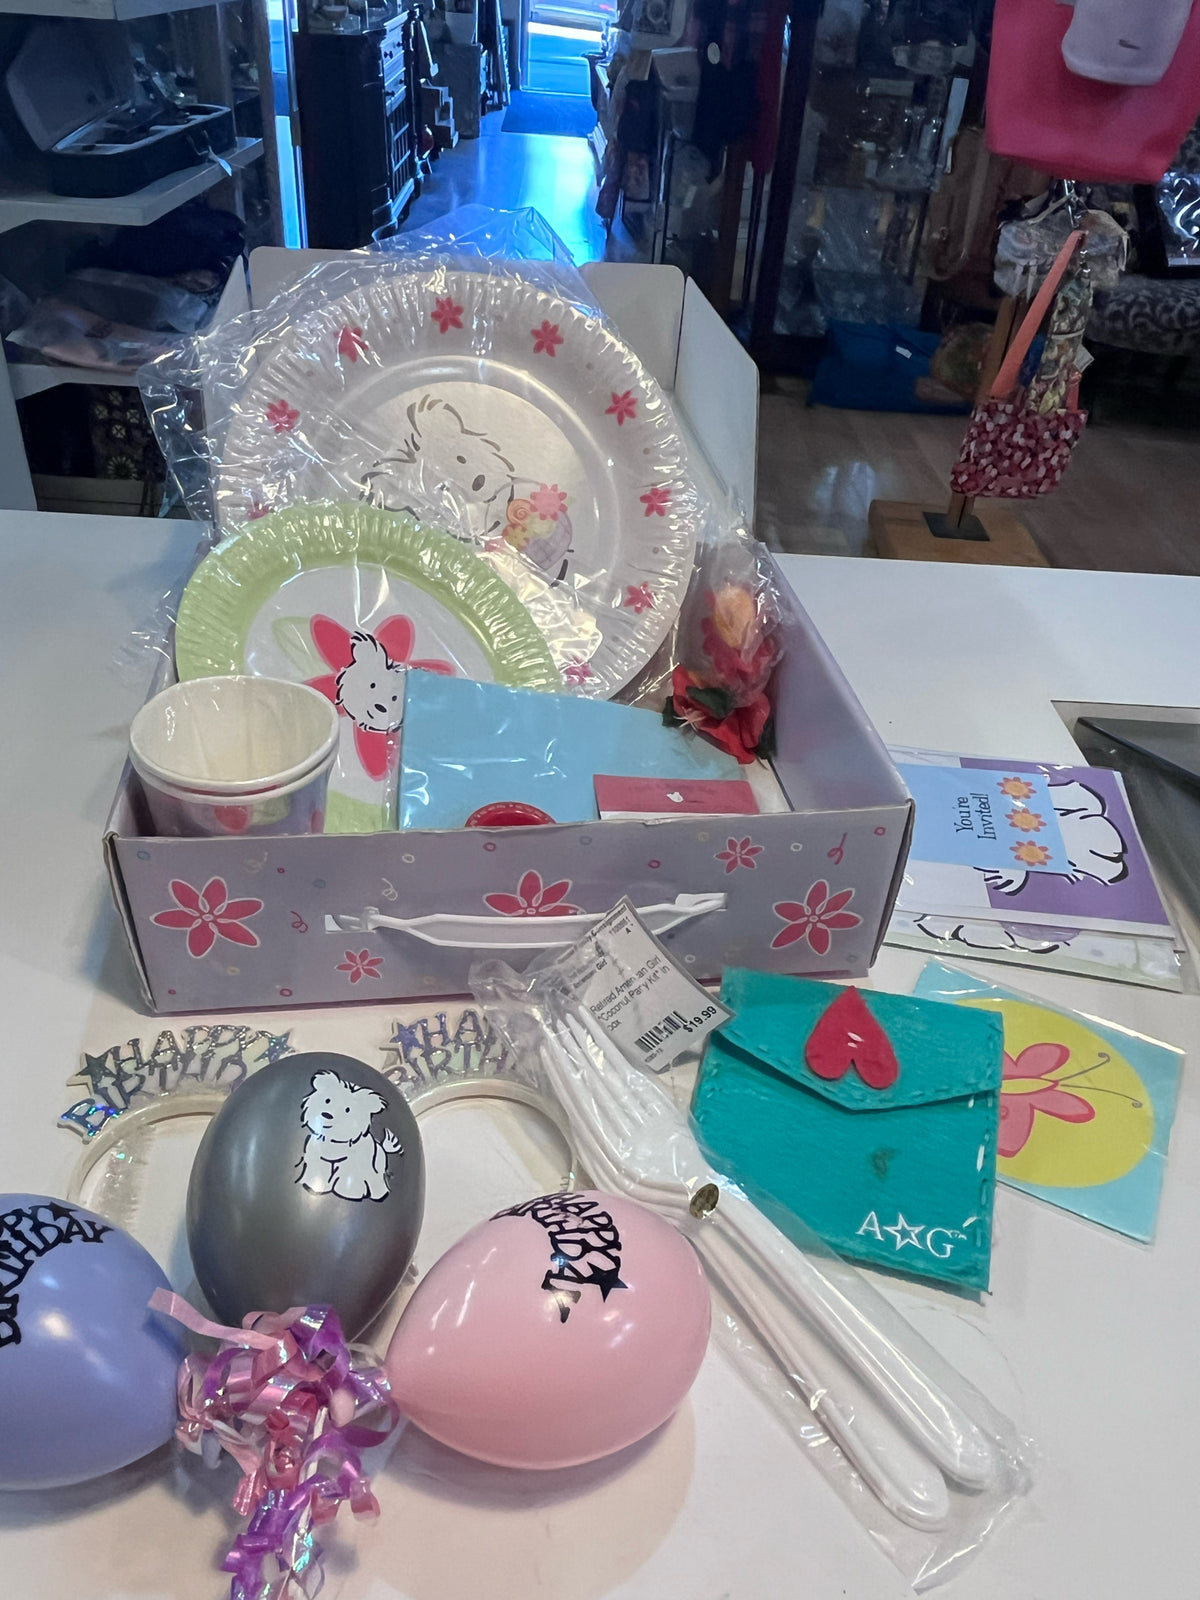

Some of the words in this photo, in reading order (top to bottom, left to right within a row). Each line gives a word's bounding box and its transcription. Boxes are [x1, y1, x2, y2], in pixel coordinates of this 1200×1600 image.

[952, 796, 974, 832] You're
[970, 793, 997, 840] Invited!
[628, 980, 650, 999] Pary
[683, 1005, 717, 1033] $19.99
[57, 1053, 248, 1138] BIRTHD
